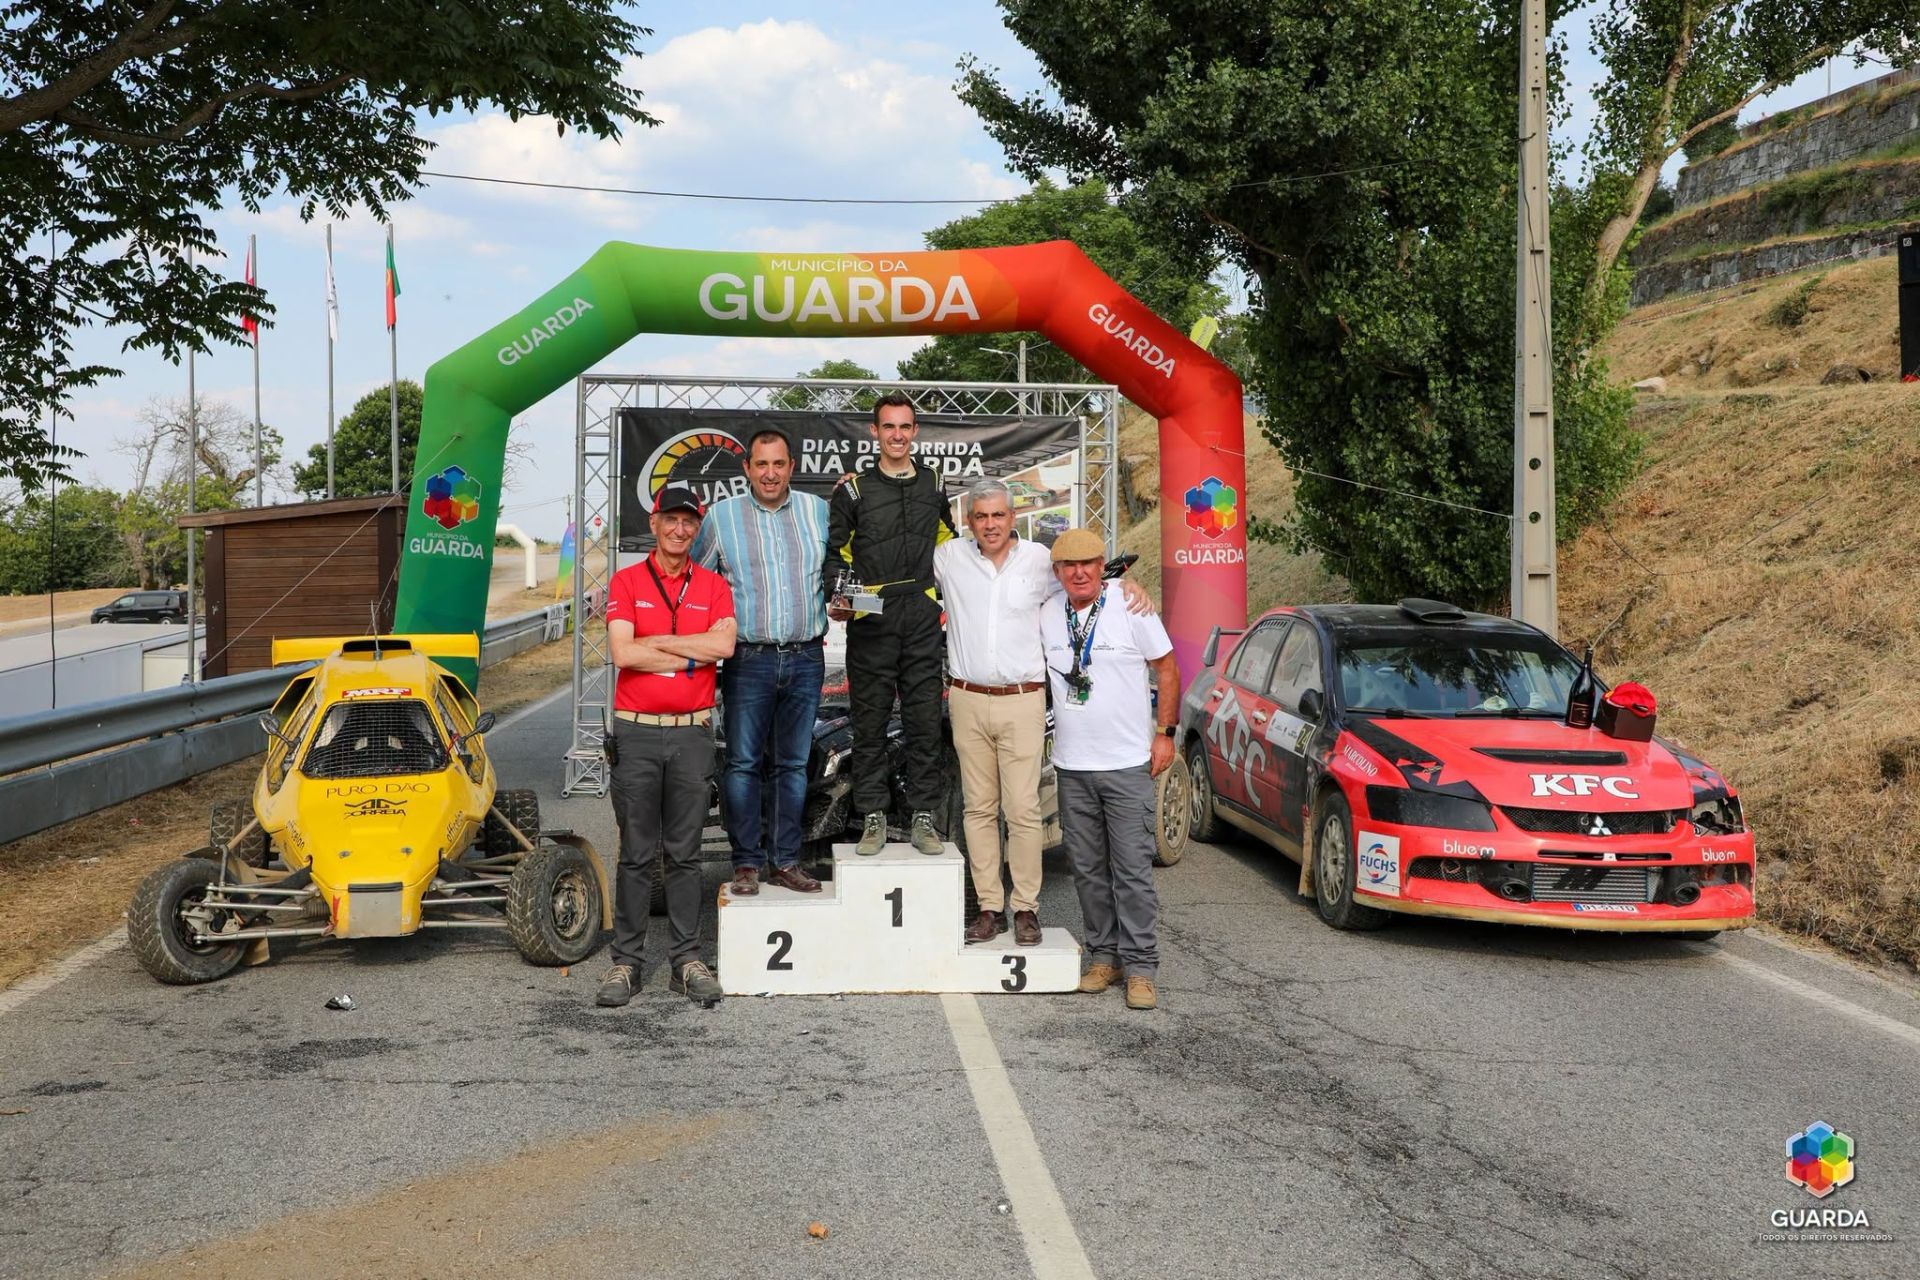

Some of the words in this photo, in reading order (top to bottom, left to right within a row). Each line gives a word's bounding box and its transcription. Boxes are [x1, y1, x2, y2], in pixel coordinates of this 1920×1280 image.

[771, 258, 874, 272] MUNICÍPIO
[880, 260, 908, 272] DA
[699, 273, 980, 323] GUARDA
[498, 297, 595, 366] GUARDA
[1088, 303, 1176, 379] GUARDA
[802, 439, 850, 453] DIAS
[909, 441, 984, 456] ORRIDA
[801, 454, 845, 474] NA
[855, 455, 985, 476] GRDA
[409, 537, 484, 560] GUARDA
[1175, 548, 1244, 565] GUARDA
[1207, 686, 1266, 809] KFC
[326, 785, 378, 799] PURO
[1528, 773, 1640, 799] KFC
[1360, 854, 1397, 873] FUCHS
[884, 887, 903, 928] 1
[766, 930, 793, 970] 2
[1000, 955, 1027, 992] 3
